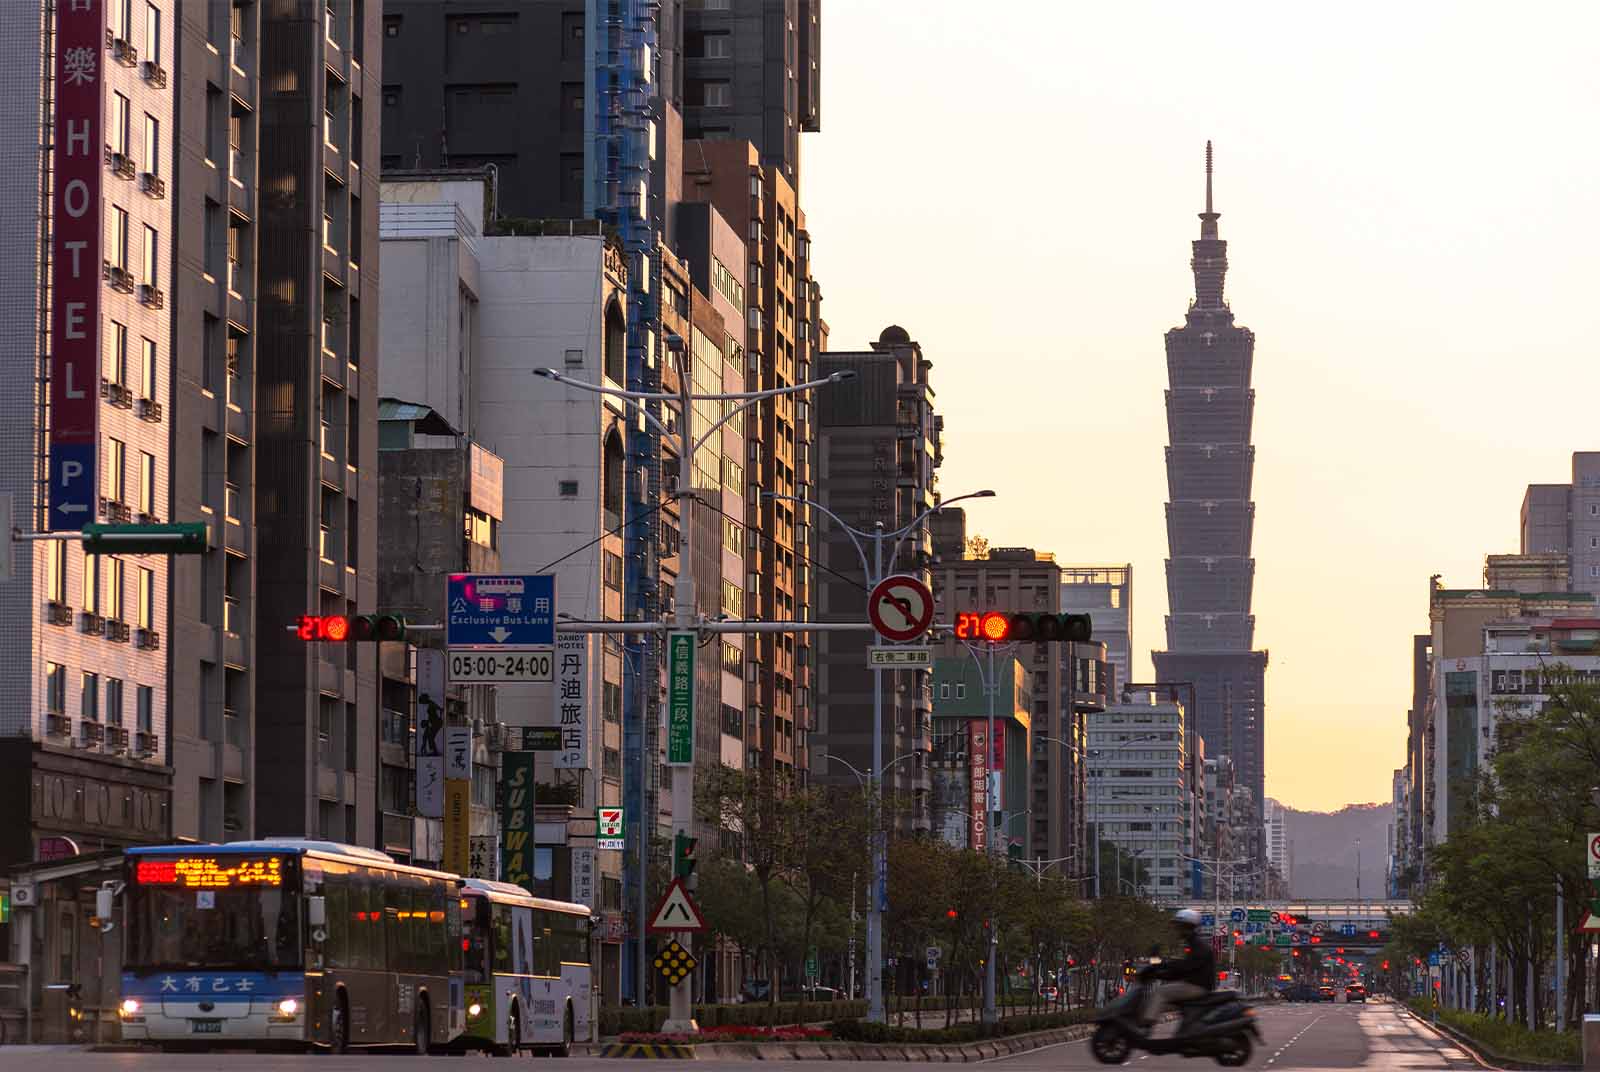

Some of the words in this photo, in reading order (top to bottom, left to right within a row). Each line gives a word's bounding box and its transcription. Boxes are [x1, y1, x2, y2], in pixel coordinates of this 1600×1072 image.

[63, 119, 91, 399] HOTEL
[61, 460, 83, 487] P
[450, 615, 500, 625] Exclusive
[503, 615, 522, 625] Bus
[524, 615, 549, 625] Lane
[451, 597, 549, 613] 公車專用
[957, 615, 980, 638] 27
[560, 653, 582, 749] 丹迪旅店
[673, 645, 689, 722] 信義路三段
[507, 767, 530, 884] SUBWAY
